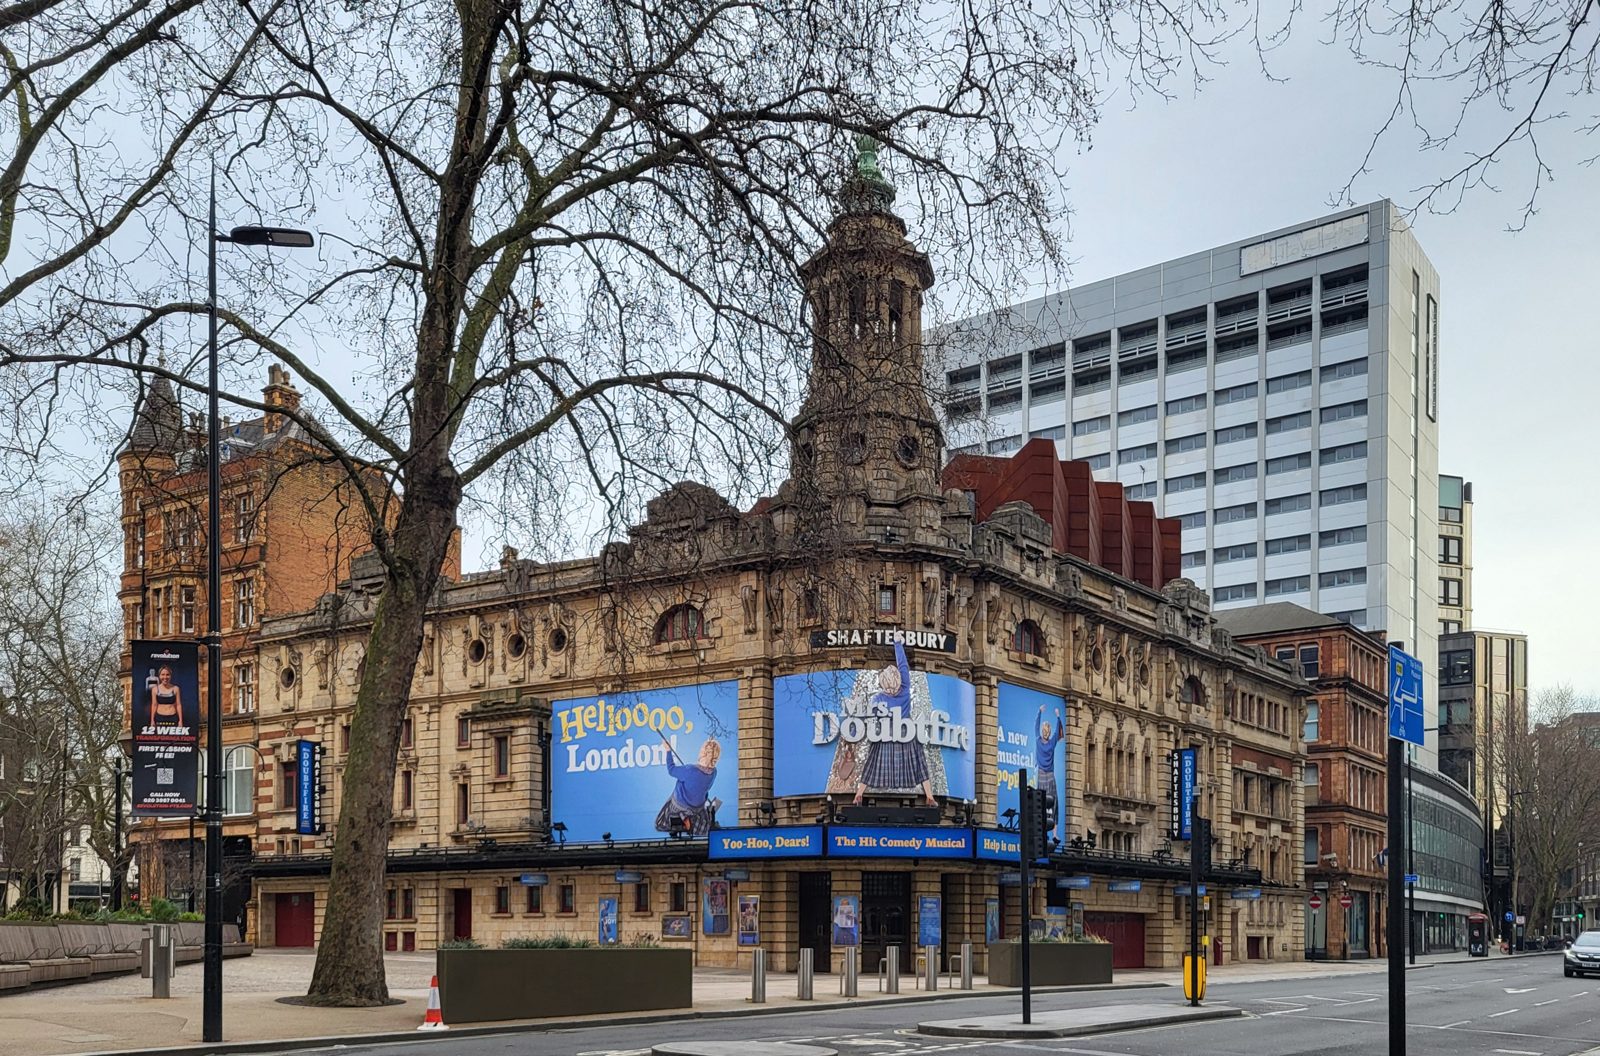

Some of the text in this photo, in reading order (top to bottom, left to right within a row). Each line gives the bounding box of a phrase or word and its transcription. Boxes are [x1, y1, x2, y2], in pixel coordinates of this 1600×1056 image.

[827, 628, 947, 650] SHAFTESBURY
[840, 699, 892, 718] Mrs.
[141, 726, 191, 735] 12 WEEK
[812, 706, 969, 751] Doubtfire
[997, 725, 1028, 747] A new
[566, 735, 678, 773] London!
[722, 835, 810, 850] Yoo-Hoo, Dears!
[835, 836, 966, 850] The Hit Comedy Musical
[984, 838, 1000, 853] Help
[1001, 840, 1007, 851] is
[1008, 843, 1016, 852] on
